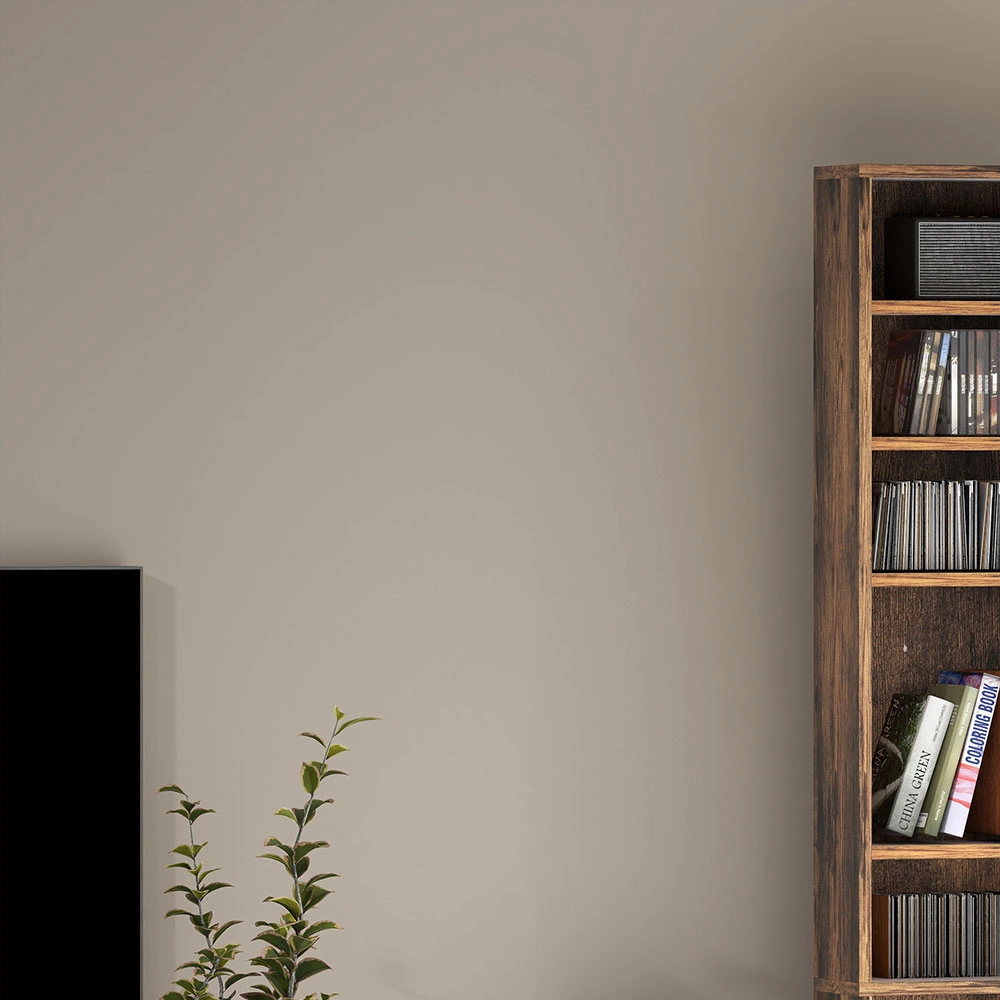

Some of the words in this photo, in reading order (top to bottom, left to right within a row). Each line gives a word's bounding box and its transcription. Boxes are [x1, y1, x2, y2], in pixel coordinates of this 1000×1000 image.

[964, 713, 991, 766] COLORING
[979, 683, 999, 714] BOOK
[898, 791, 920, 831] CHINA
[912, 750, 932, 790] GREEN
